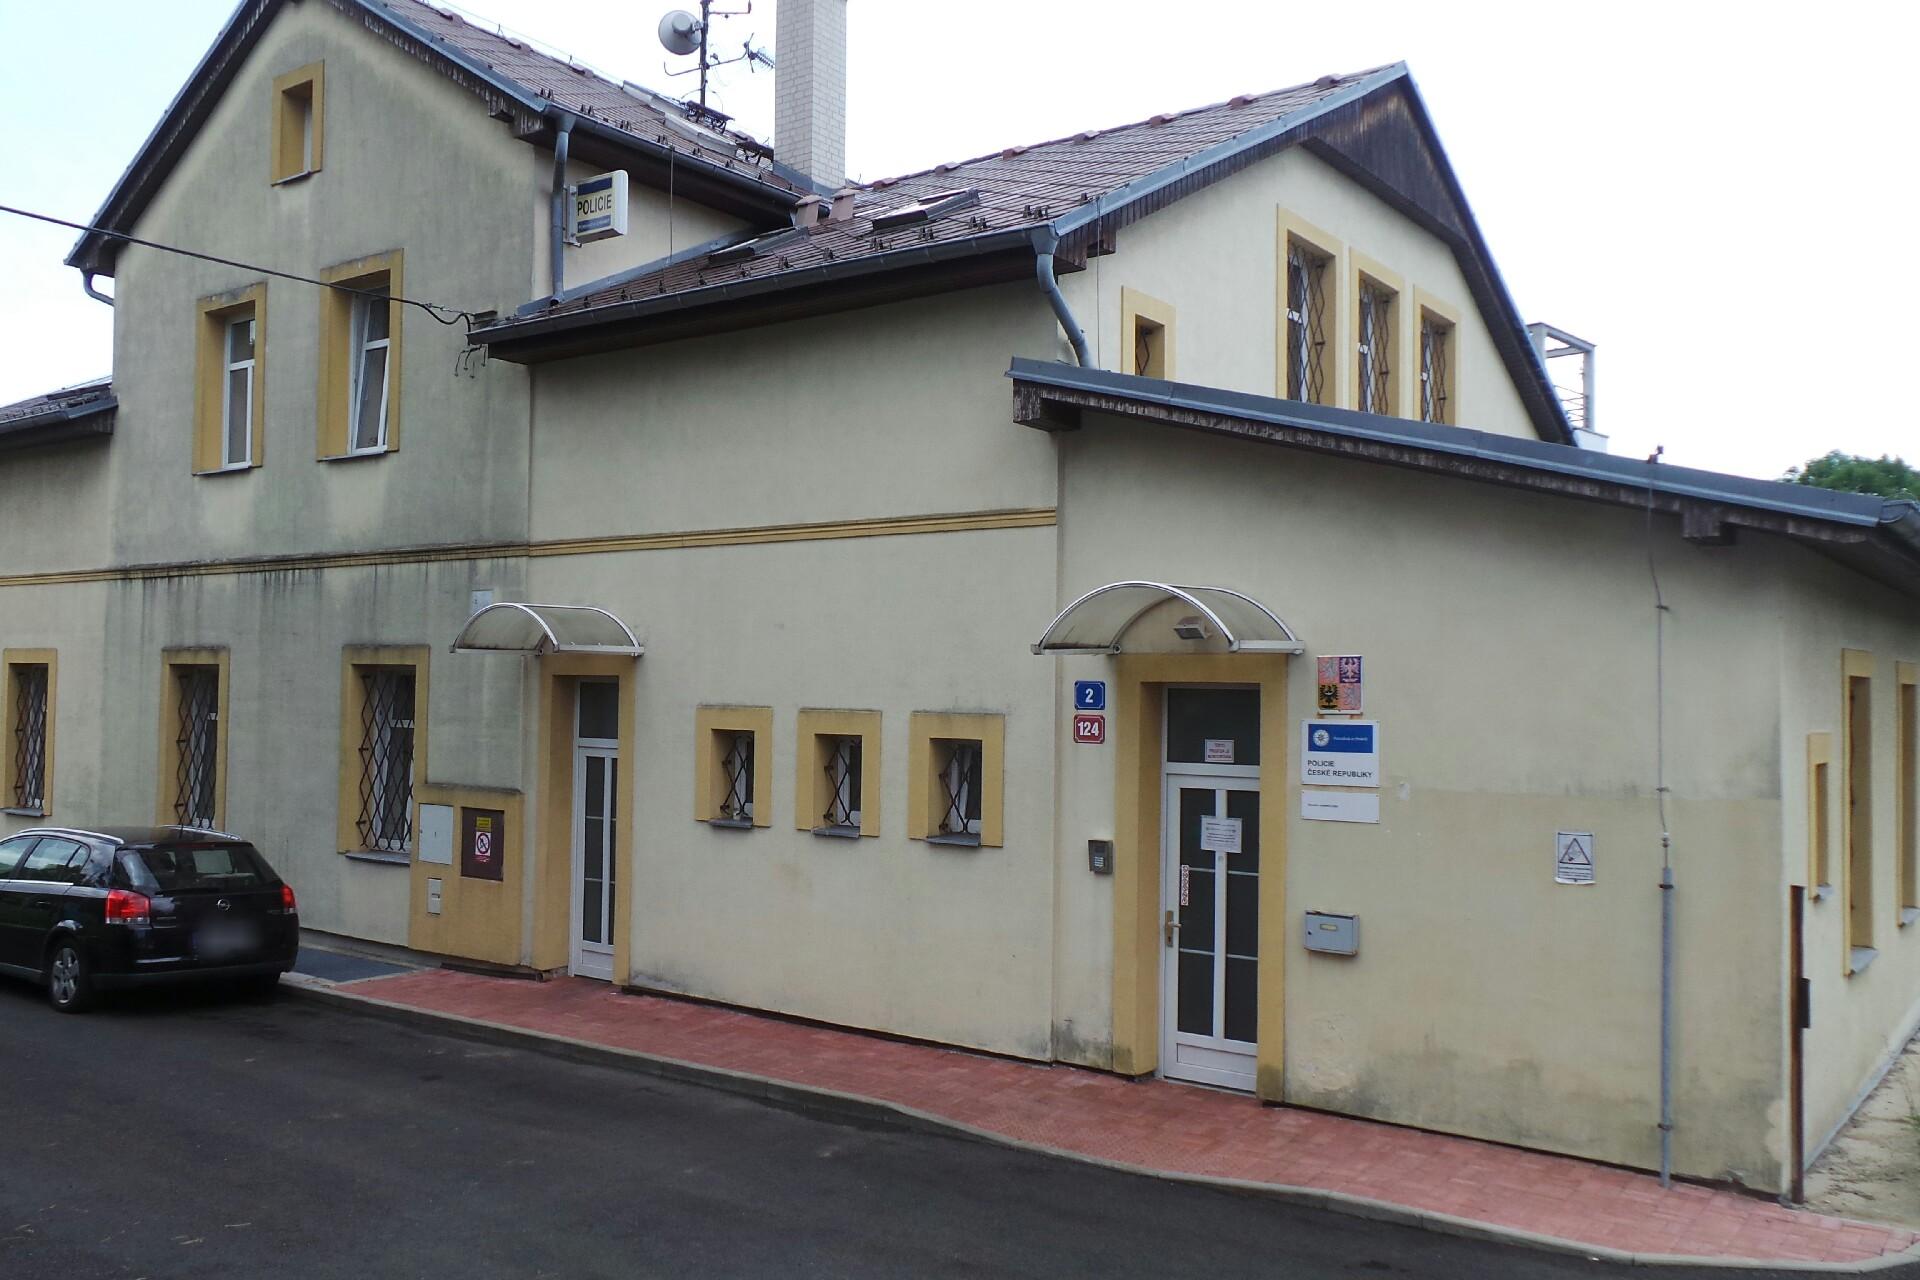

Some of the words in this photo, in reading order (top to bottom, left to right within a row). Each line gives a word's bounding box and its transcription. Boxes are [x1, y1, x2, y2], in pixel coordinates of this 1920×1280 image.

[577, 194, 612, 216] POLICIE
[1085, 688, 1094, 704] 2
[1077, 721, 1100, 737] 124
[1307, 759, 1335, 767] POLICIE
[1307, 768, 1331, 776] ČESKÉ
[1332, 770, 1373, 778] REPUBLIKY
